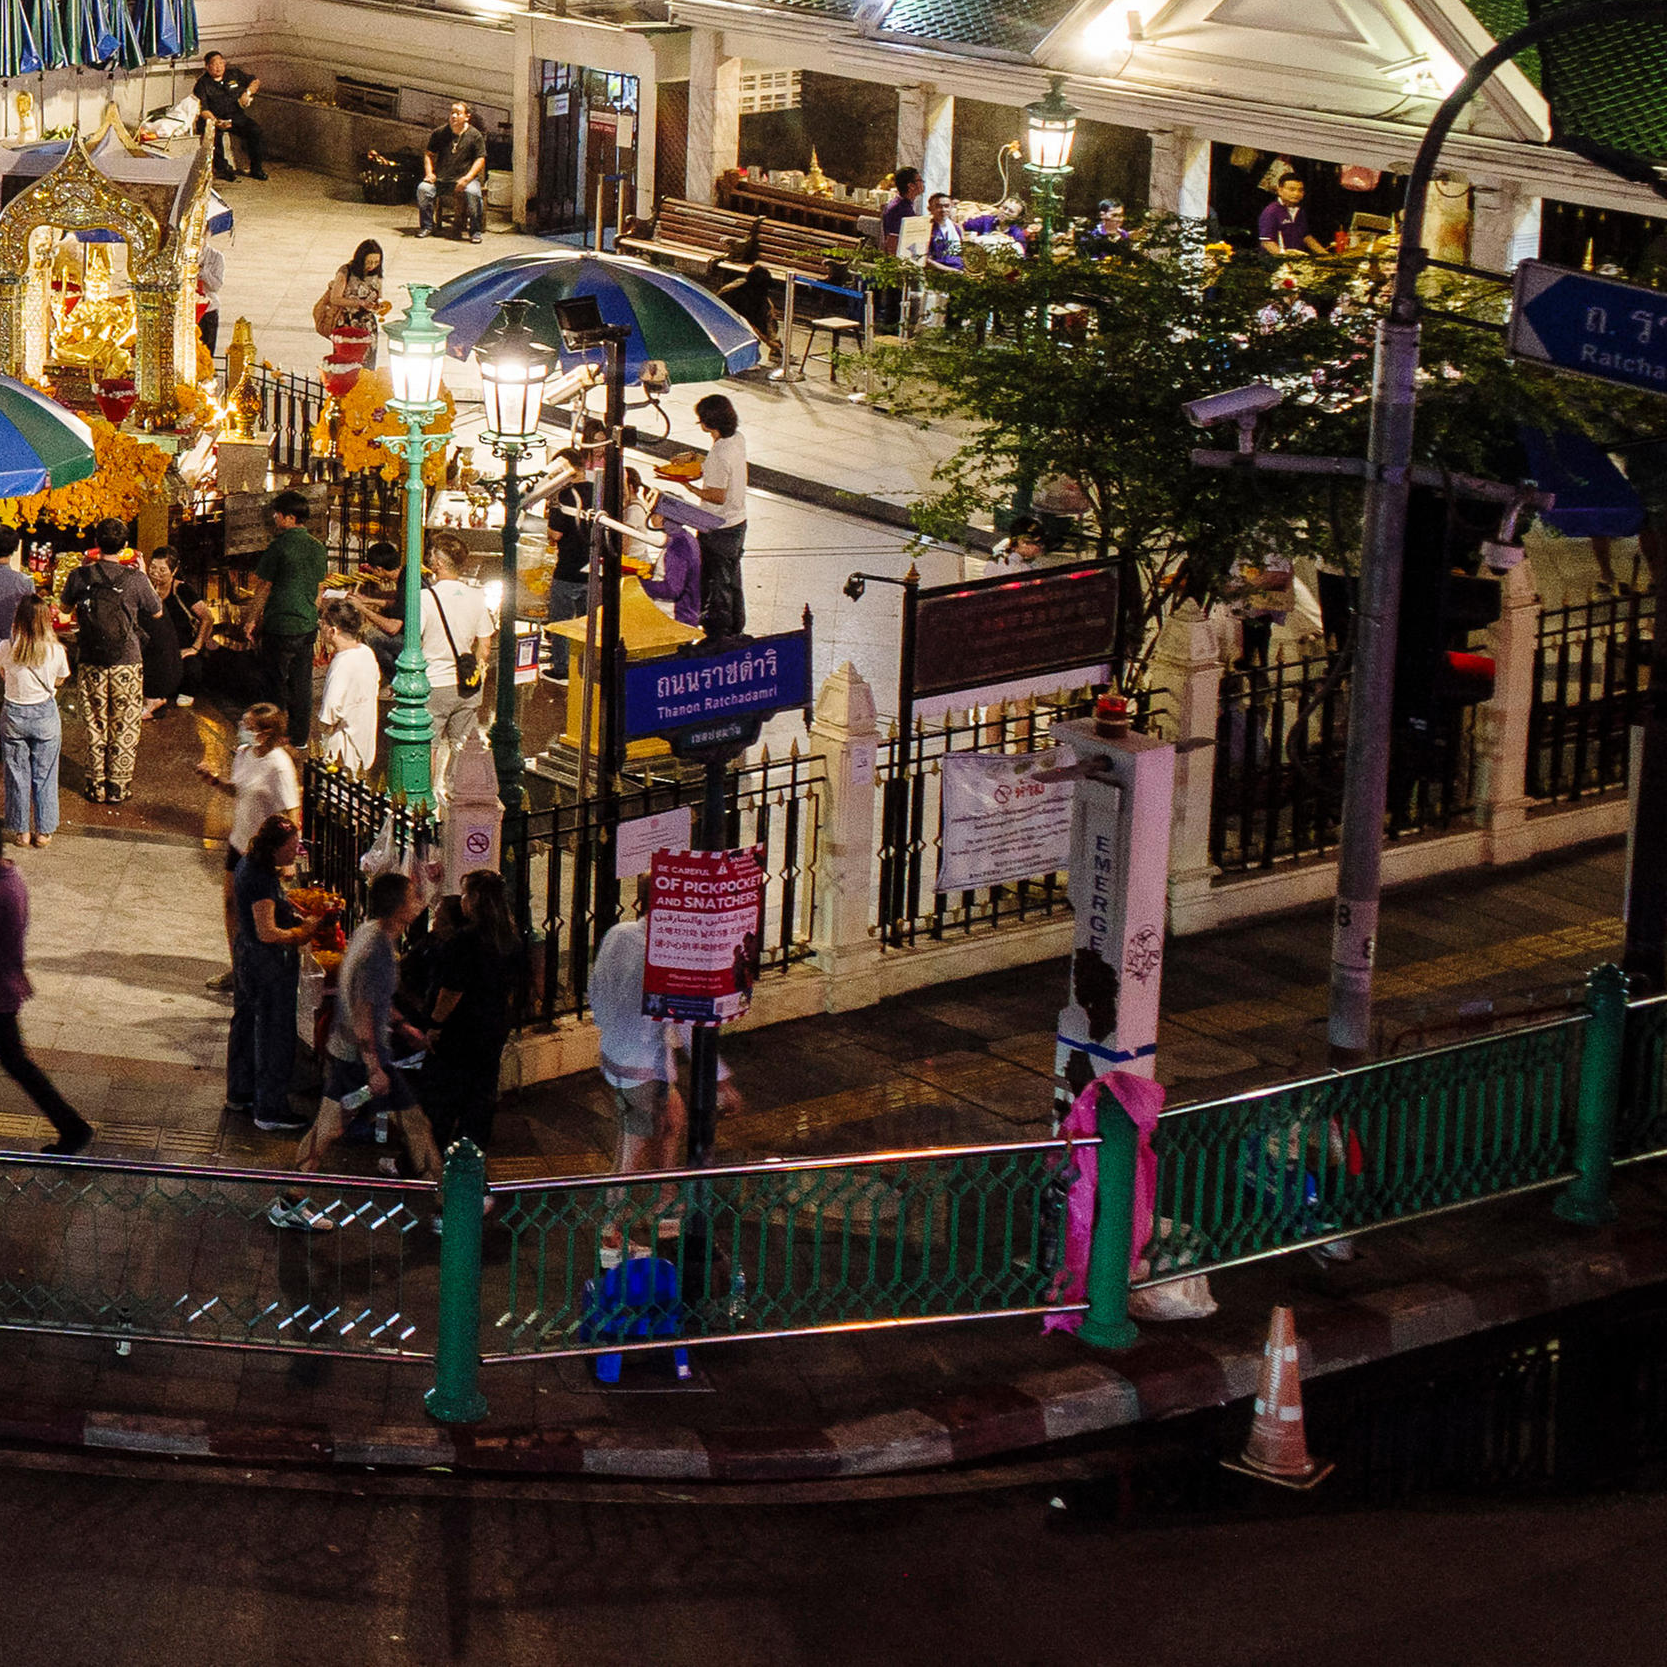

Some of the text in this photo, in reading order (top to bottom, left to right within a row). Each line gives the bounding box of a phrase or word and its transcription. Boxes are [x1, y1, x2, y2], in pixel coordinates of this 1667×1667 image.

[657, 648, 778, 698] ถนนราชดำริ
[657, 685, 778, 720] Thanon Ratchadamri
[657, 864, 710, 876] BE CAREFUL
[655, 874, 762, 894] OF PICKPOCKET
[656, 890, 759, 909] AND SNATCHERS
